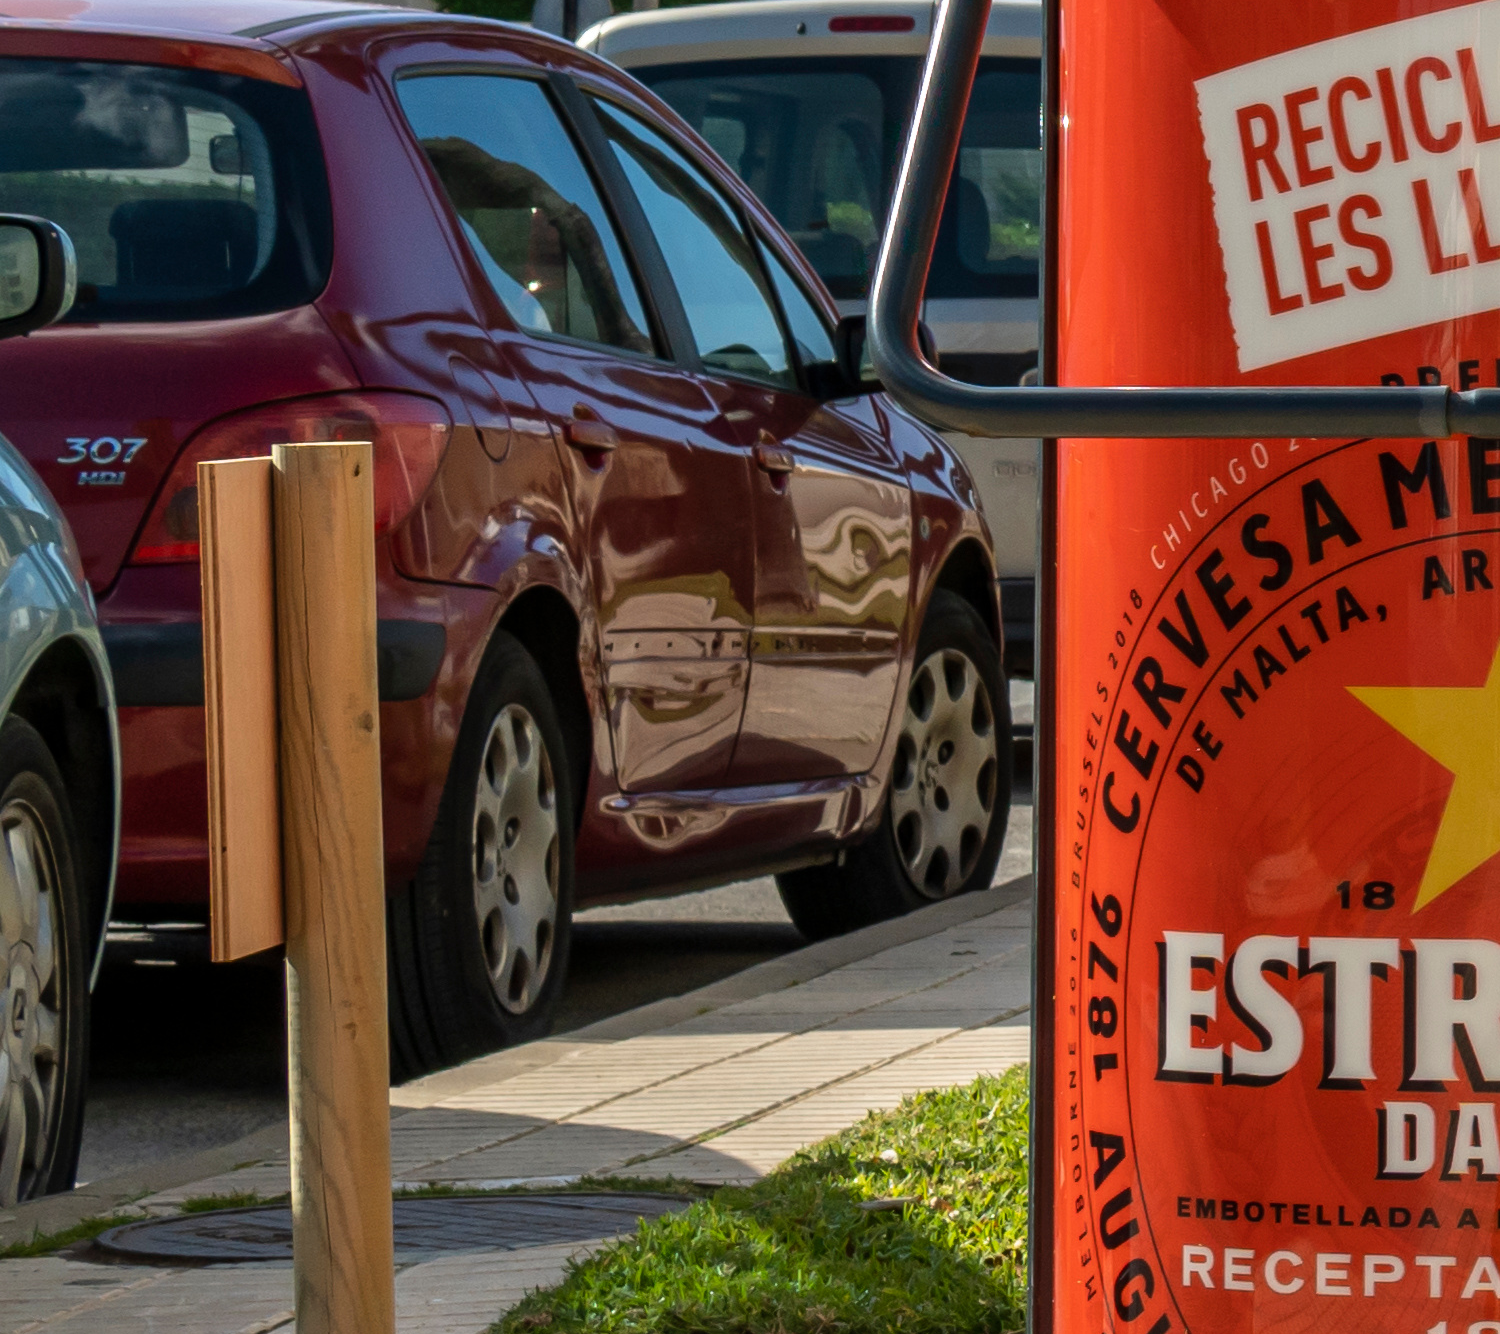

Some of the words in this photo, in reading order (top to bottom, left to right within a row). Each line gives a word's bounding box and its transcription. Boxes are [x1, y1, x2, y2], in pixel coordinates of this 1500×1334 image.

[1254, 193, 1395, 316] LES
[56, 436, 149, 464] 307
[1071, 680, 1109, 890] BRUSSELS
[1108, 587, 1143, 670] 2018
[1150, 442, 1270, 570] CHICAGO
[1102, 477, 1364, 835] CERVESA
[1174, 721, 1224, 795] DE
[1219, 586, 1388, 720] MALTA,
[1421, 547, 1494, 600] AR
[1088, 892, 1123, 1082] 1876
[1335, 881, 1396, 912] 18
[1067, 1040, 1098, 1303] MELBOURNE
[1176, 1195, 1442, 1229] EMBOTELLADA
[1456, 1206, 1481, 1229] A
